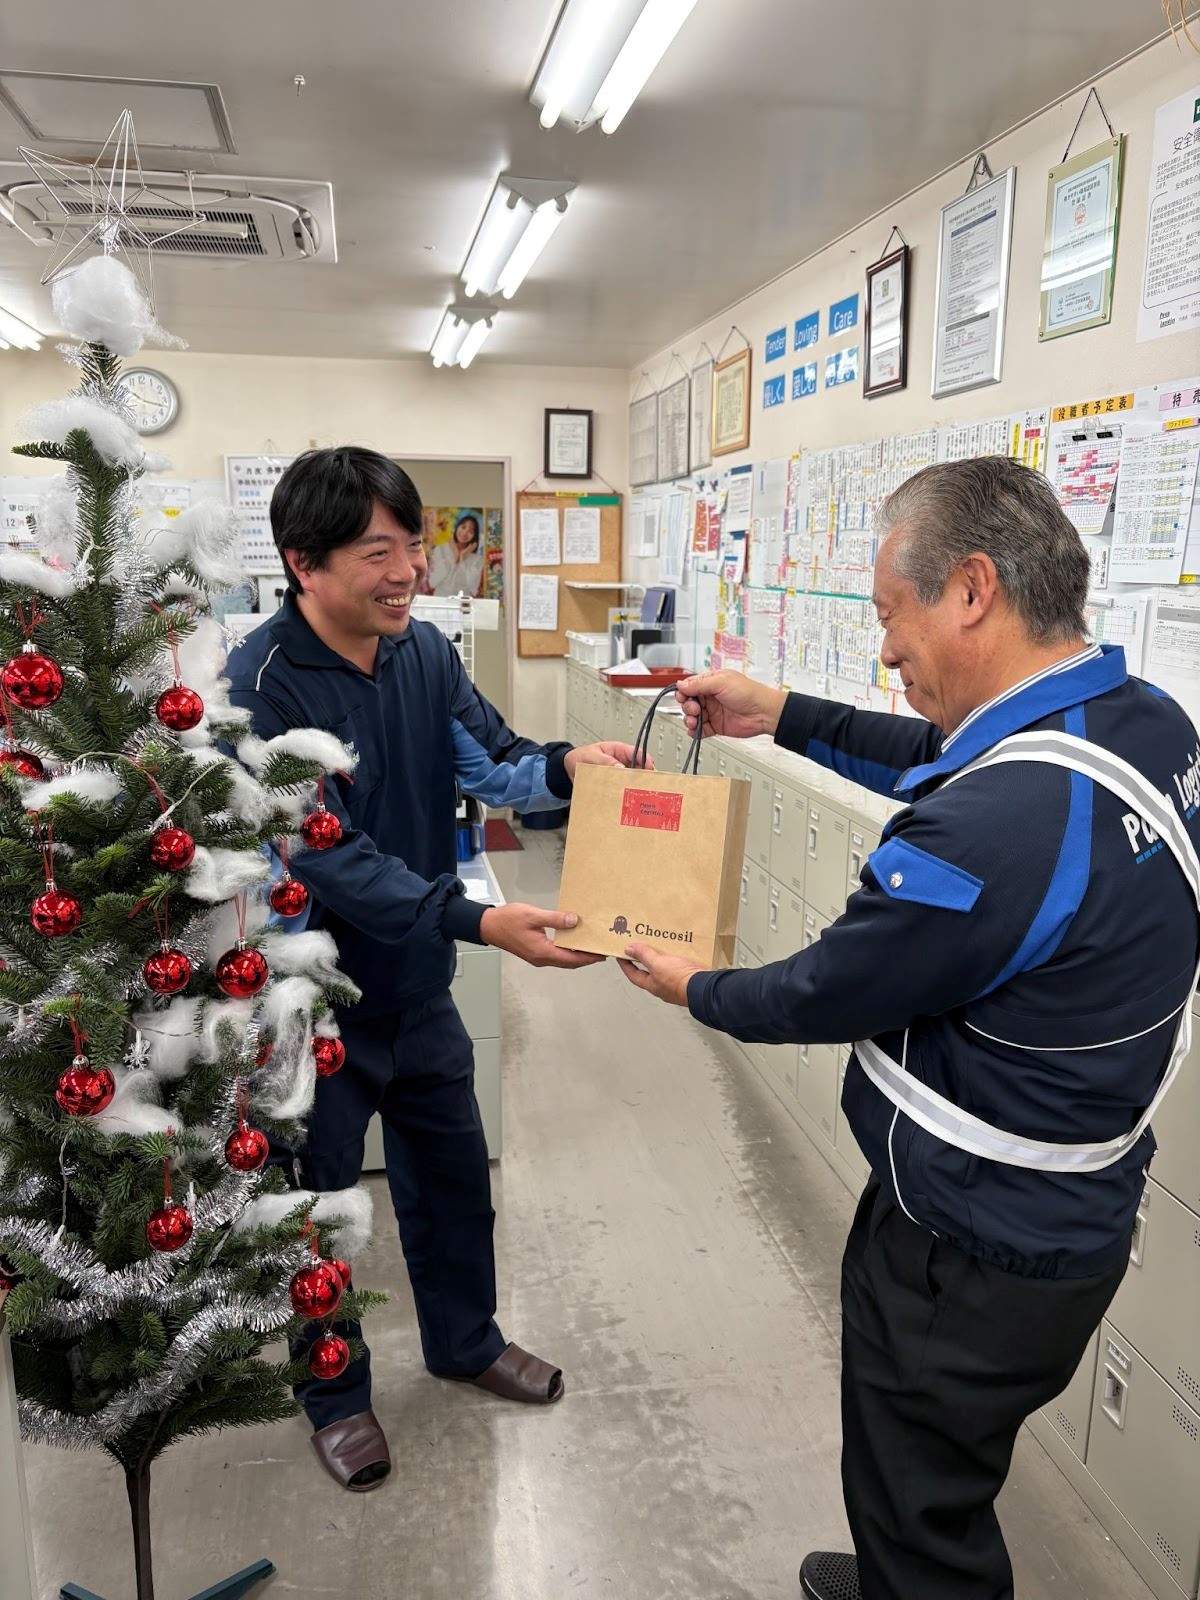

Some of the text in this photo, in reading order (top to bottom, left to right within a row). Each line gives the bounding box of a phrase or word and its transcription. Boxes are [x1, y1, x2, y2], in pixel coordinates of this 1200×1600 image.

[795, 324, 818, 346] Loving
[833, 310, 853, 331] Care
[5, 518, 16, 527] 12
[634, 923, 694, 943] Chocosil
